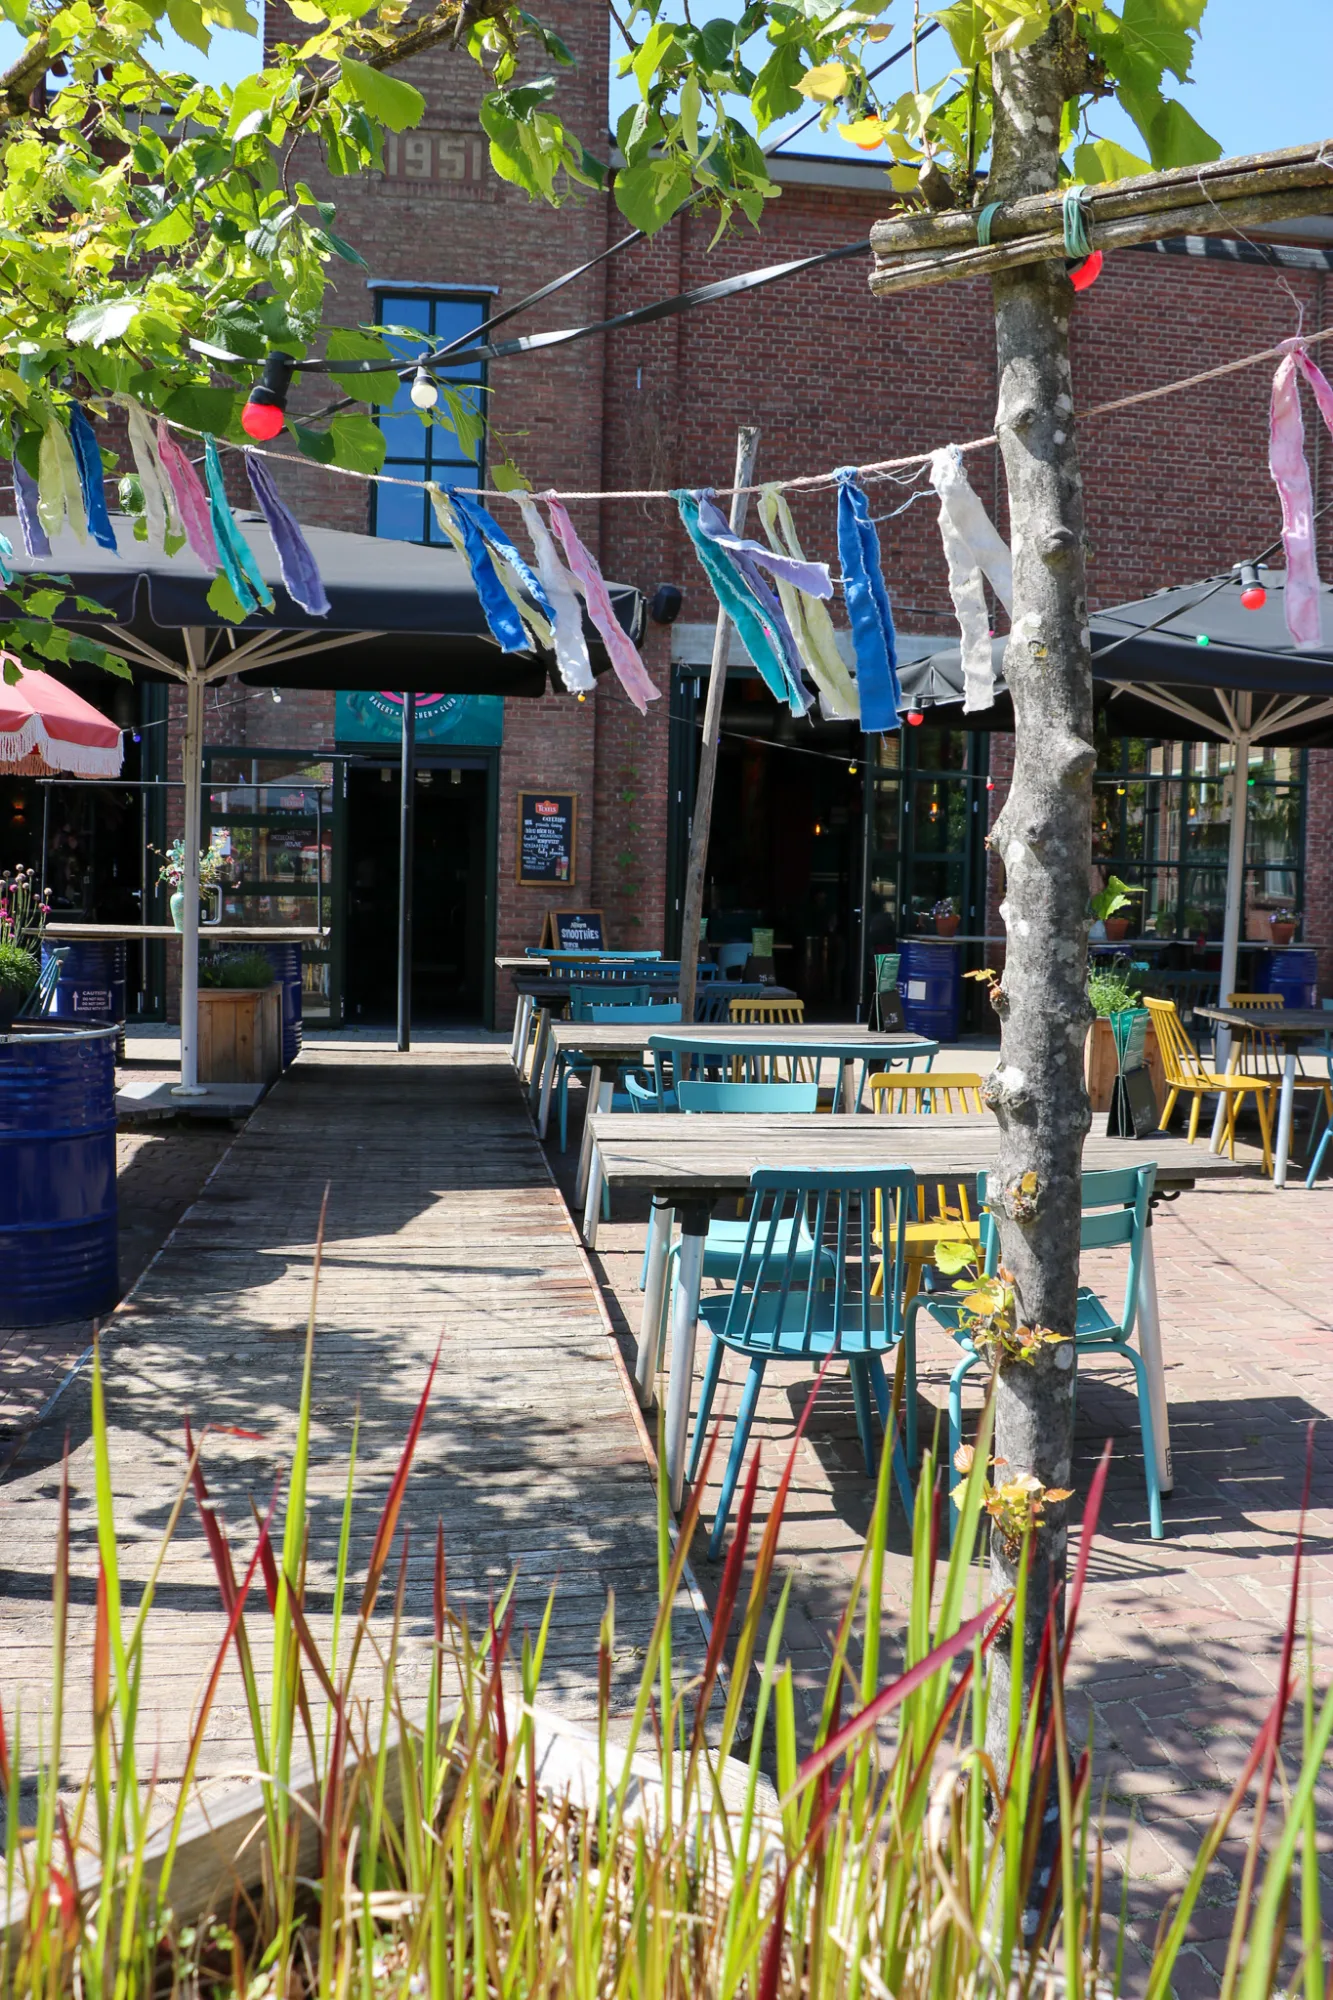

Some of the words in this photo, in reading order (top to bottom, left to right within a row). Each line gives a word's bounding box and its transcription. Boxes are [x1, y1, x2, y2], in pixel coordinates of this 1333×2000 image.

[388, 136, 483, 181] 1951
[369, 696, 394, 715] BAKERY
[440, 698, 456, 712] CLUB
